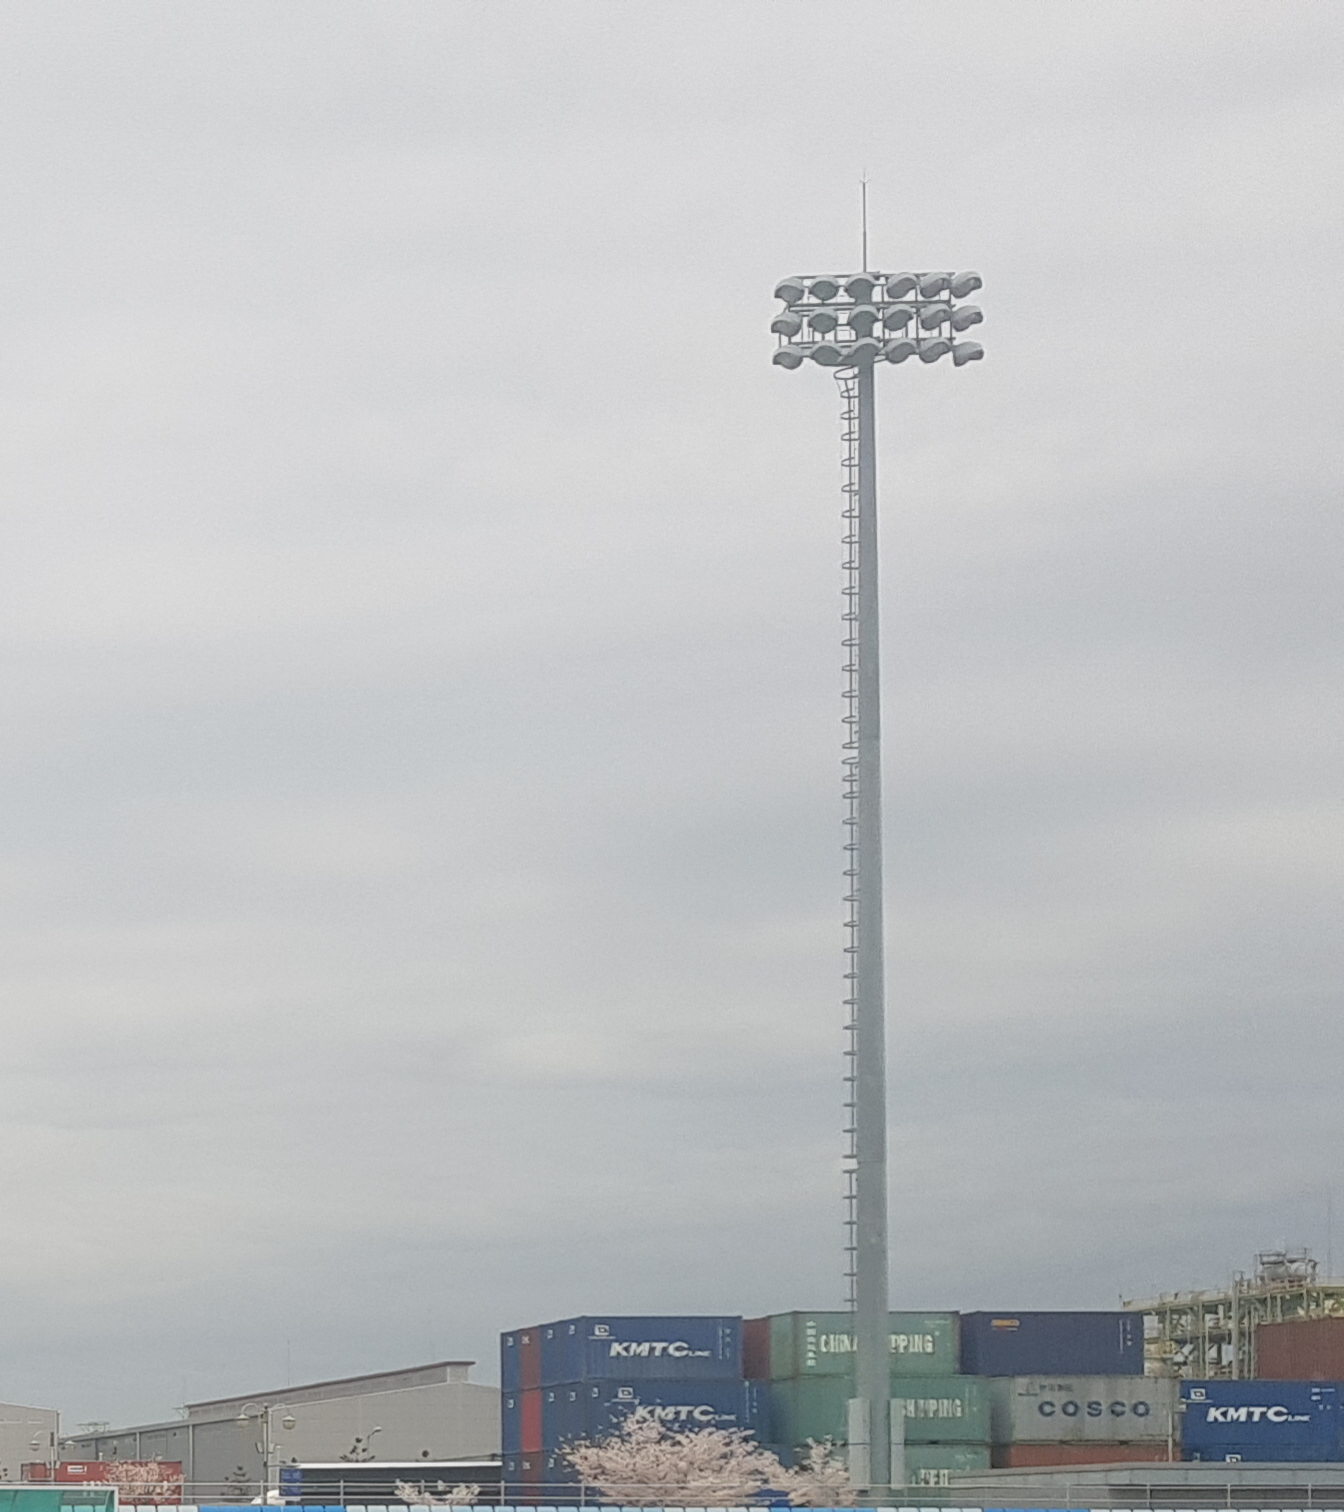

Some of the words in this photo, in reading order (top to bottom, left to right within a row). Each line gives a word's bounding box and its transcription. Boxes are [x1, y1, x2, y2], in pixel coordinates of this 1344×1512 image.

[609, 1341, 689, 1357] KMTC
[634, 1405, 715, 1421] KMTC
[1038, 1401, 1150, 1417] COSCO
[1206, 1406, 1288, 1422] KMTC
